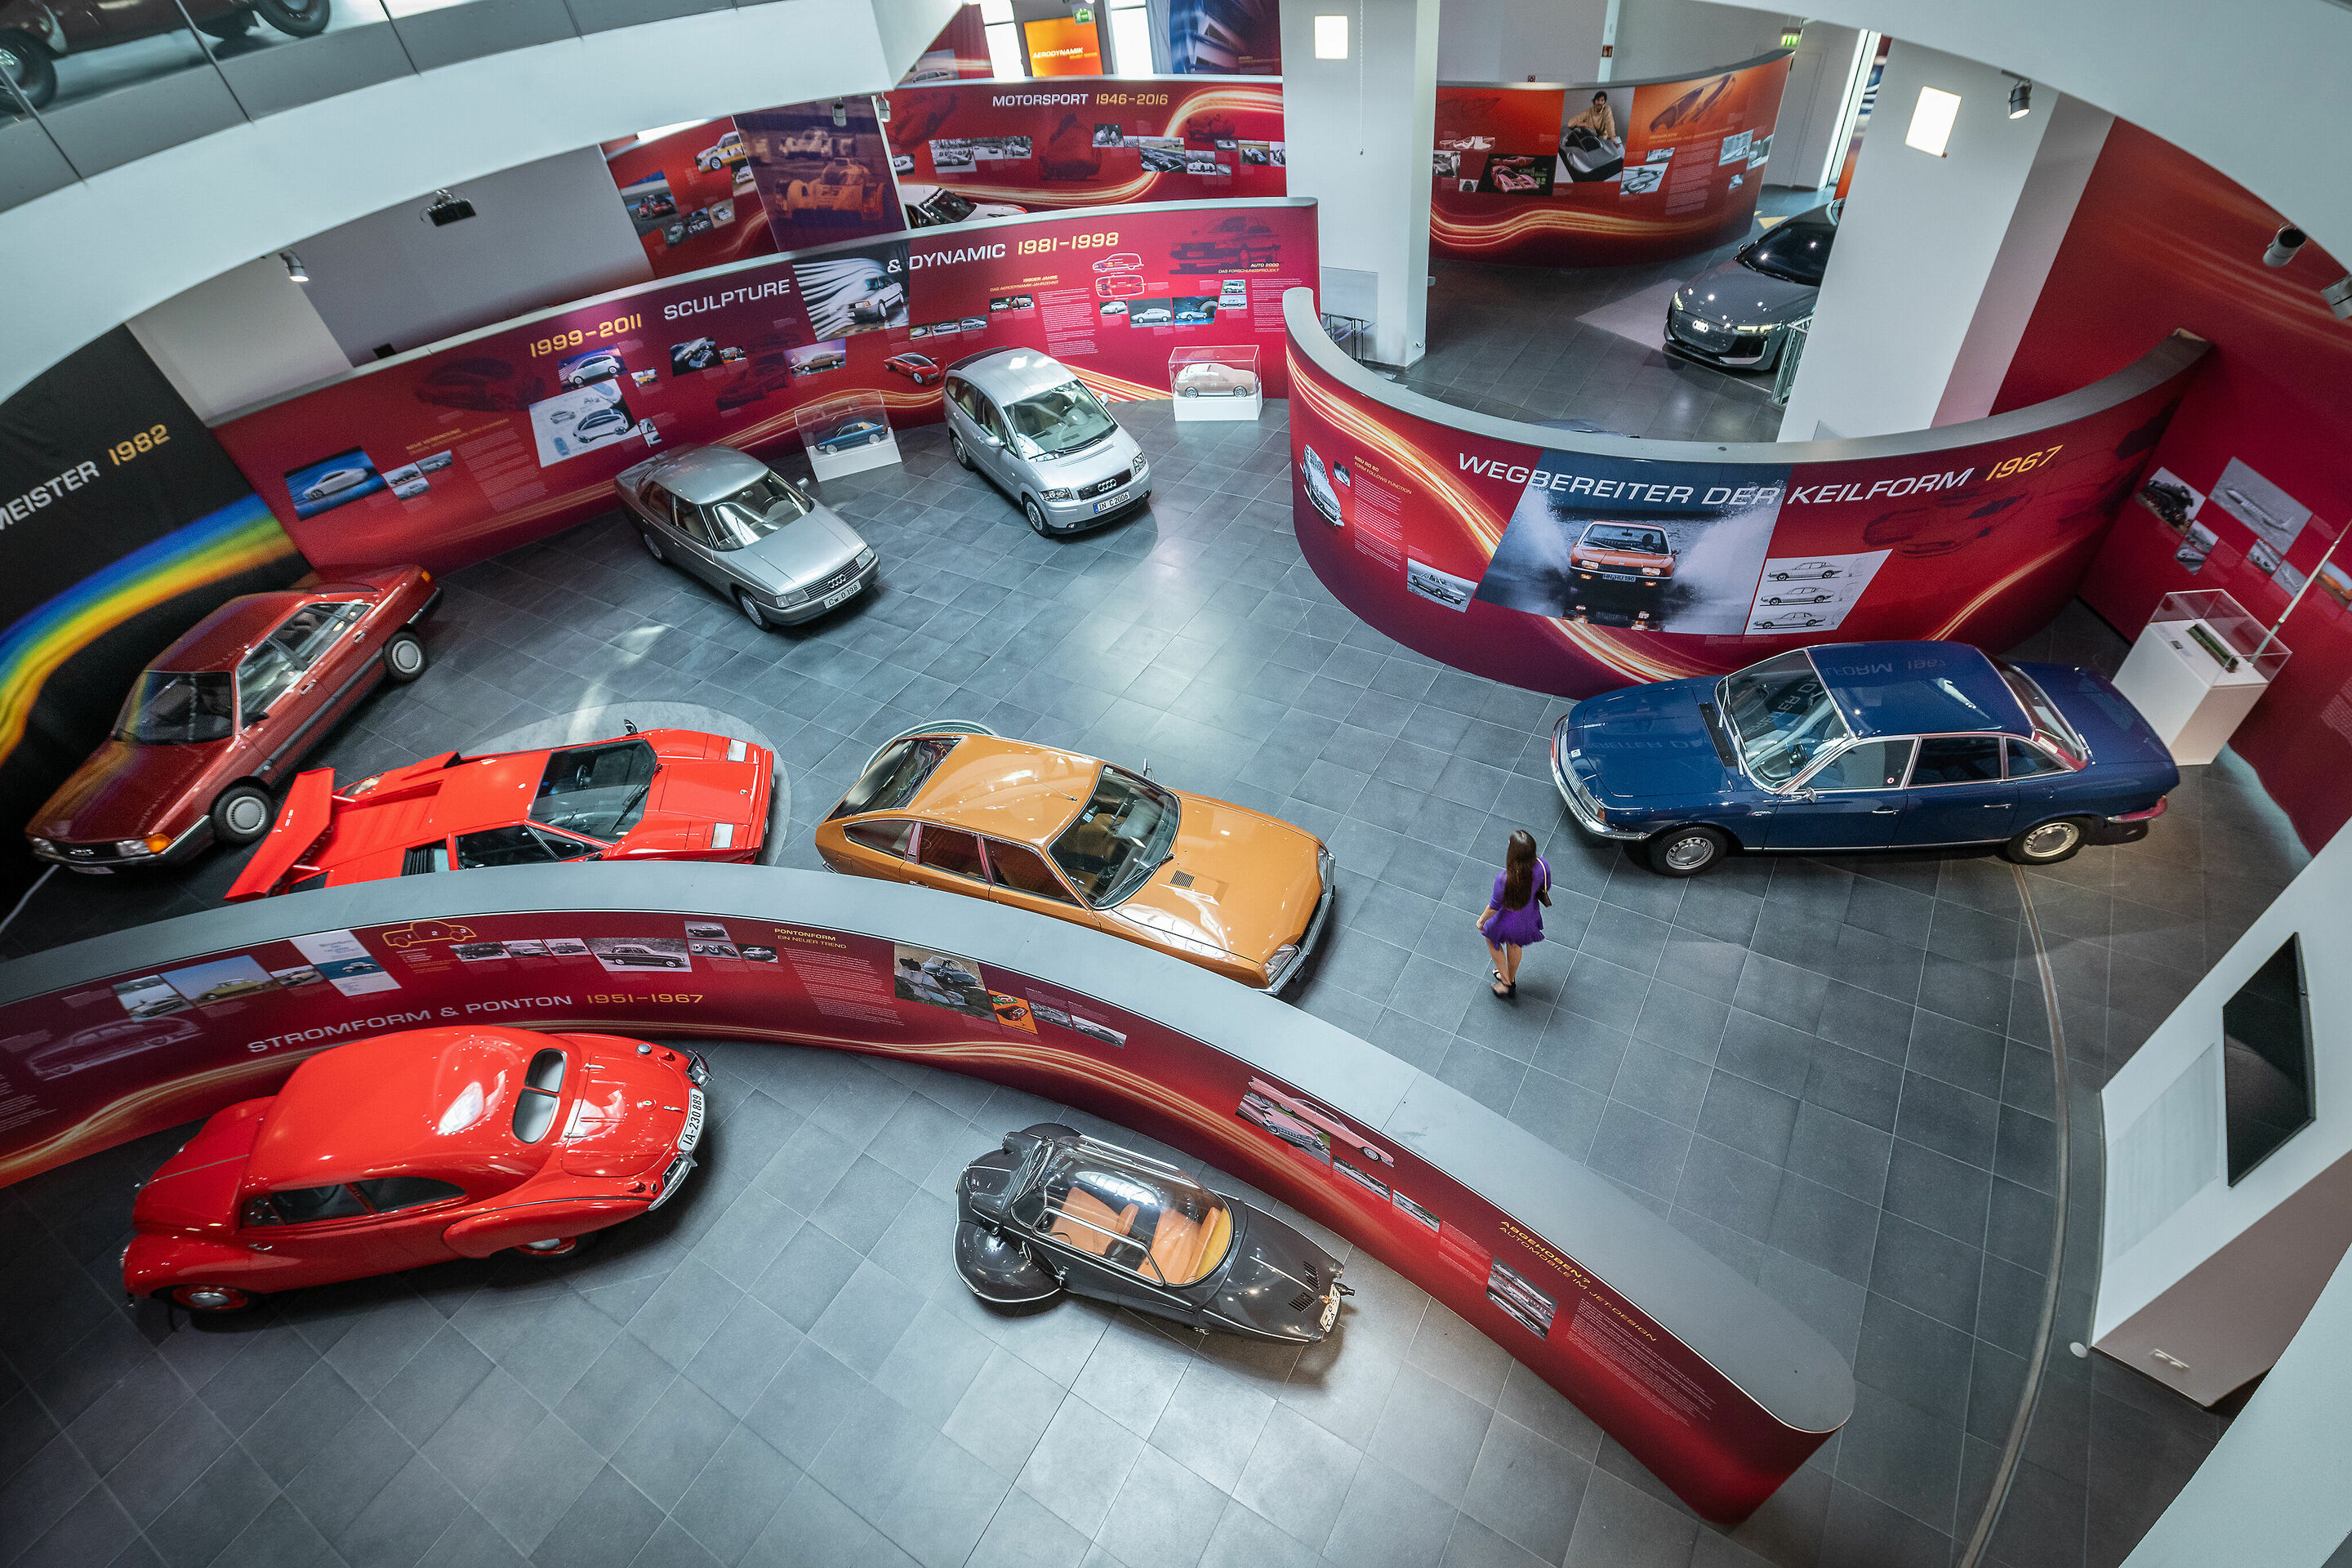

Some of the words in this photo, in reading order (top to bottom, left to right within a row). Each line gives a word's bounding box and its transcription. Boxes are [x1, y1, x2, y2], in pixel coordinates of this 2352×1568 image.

[1032, 47, 1084, 58] AERODYNAMIK
[992, 93, 1089, 107] MOTORSPORT
[1095, 93, 1169, 105] 1946-2016
[530, 313, 642, 358] 1999-2011
[663, 278, 791, 320] SCULPTURE
[887, 258, 902, 274] &
[909, 243, 1006, 270] DYNAMIC
[1018, 232, 1120, 255] 1981-1998
[108, 424, 171, 466] 1982
[1354, 461, 1366, 472] FORM
[1365, 466, 1388, 483] FOLLOWS
[1388, 479, 1412, 495] FUNCTION
[1459, 452, 1694, 504] WEGBEREITER
[1700, 487, 1782, 506] DER
[1787, 467, 1976, 505] KEILFORM
[1985, 444, 2064, 481] 1967
[1098, 502, 1107, 510] IN
[1115, 492, 1129, 504] 2006
[847, 584, 858, 595] 198
[774, 929, 835, 941] PONTONFORM
[792, 936, 818, 944] NEUER
[820, 939, 847, 949] TREND
[247, 1009, 431, 1053] STROMFORM
[440, 1007, 459, 1017] &
[466, 996, 572, 1013] PONTON
[586, 994, 704, 1004] 1951-1967
[683, 1111, 702, 1145] IA-230
[693, 1094, 702, 1111] 889
[1500, 1221, 1591, 1283] ABGEHOBEN?
[1499, 1227, 1571, 1278] AUTOMOBILE
[1573, 1278, 1588, 1290] IM
[1589, 1291, 1657, 1342] JET-DESIGN
